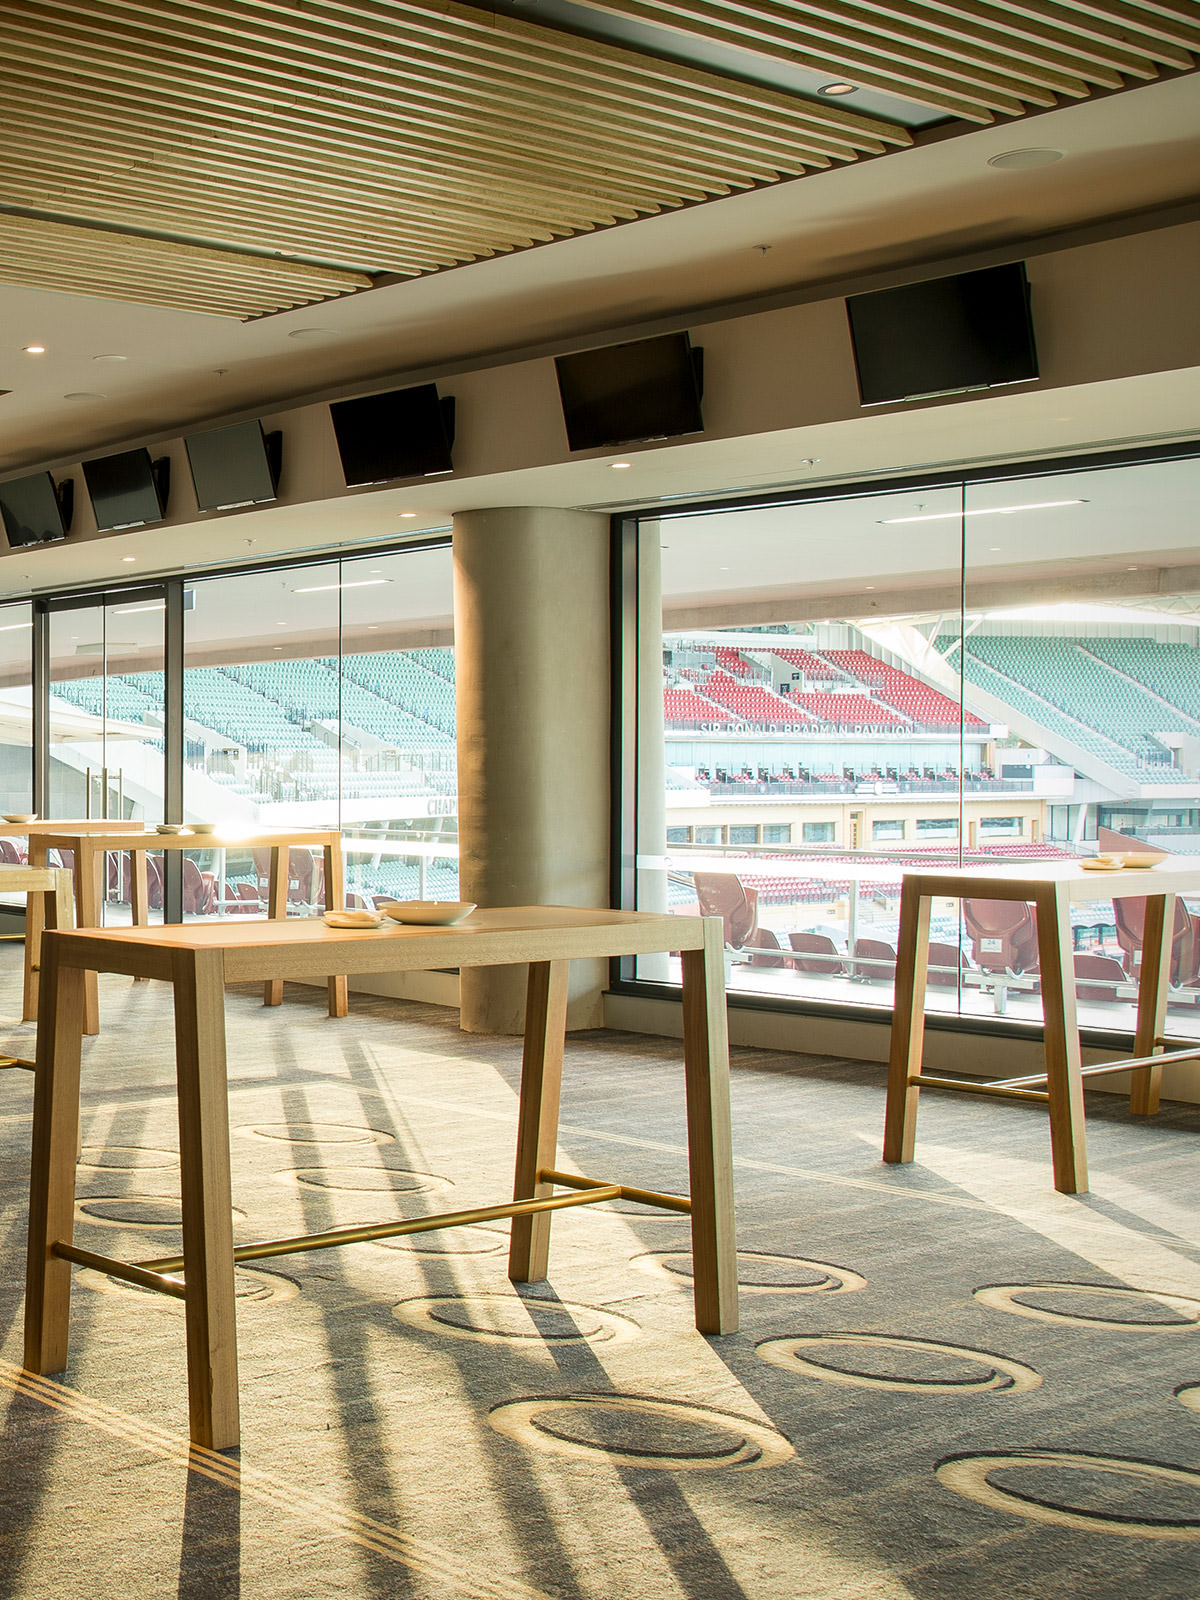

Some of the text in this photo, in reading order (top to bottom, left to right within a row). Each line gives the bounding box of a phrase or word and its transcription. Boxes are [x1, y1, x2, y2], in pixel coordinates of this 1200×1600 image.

[700, 723, 914, 738] SIR DONALD BRADMAN PAVILION
[427, 798, 458, 816] CHAP
